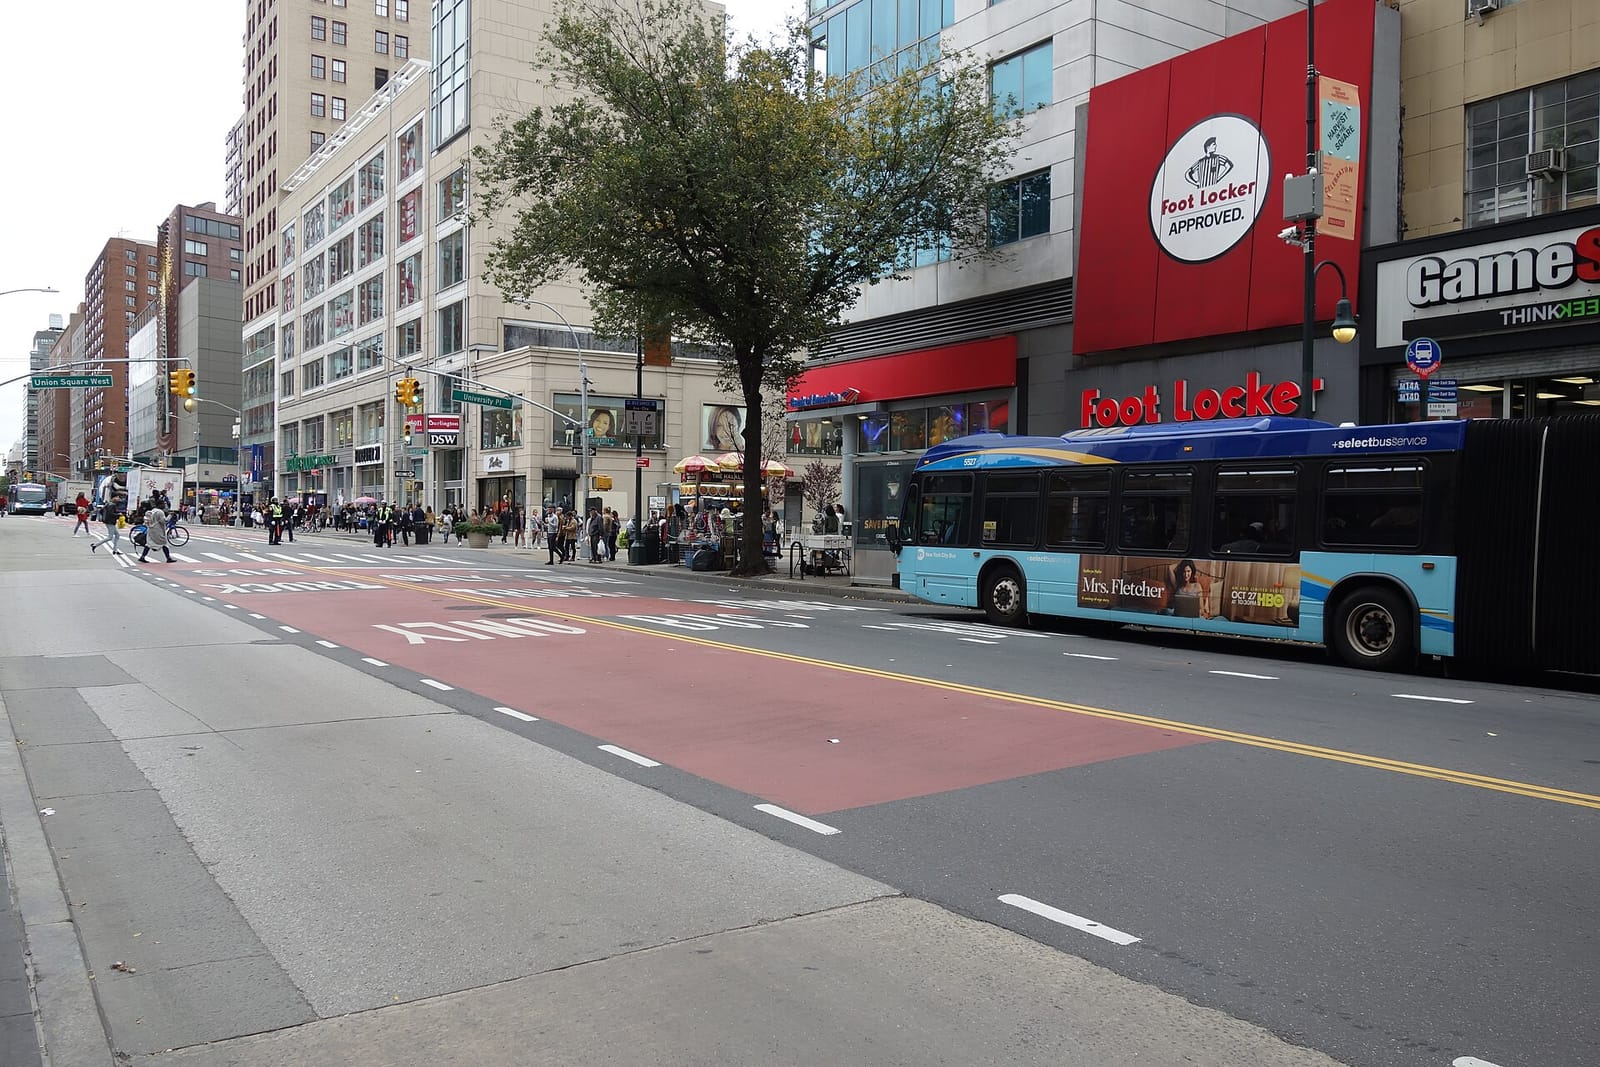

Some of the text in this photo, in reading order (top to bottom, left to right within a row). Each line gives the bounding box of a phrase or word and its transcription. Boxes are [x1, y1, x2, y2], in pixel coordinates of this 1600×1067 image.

[1161, 181, 1256, 215] Foot Locker
[1168, 207, 1244, 236] APPROVED.
[60, 378, 89, 386] Square
[463, 394, 494, 406] University
[1080, 384, 1161, 428] Foot
[430, 434, 456, 444] DSW
[864, 519, 881, 529] SAVE
[200, 580, 388, 594] TRUCK
[1082, 576, 1165, 599] Mrs. Fletcher
[1231, 590, 1257, 600] OCT 27
[1257, 592, 1285, 608] HBO
[616, 613, 810, 631] BUS
[371, 618, 587, 645] ONLY
